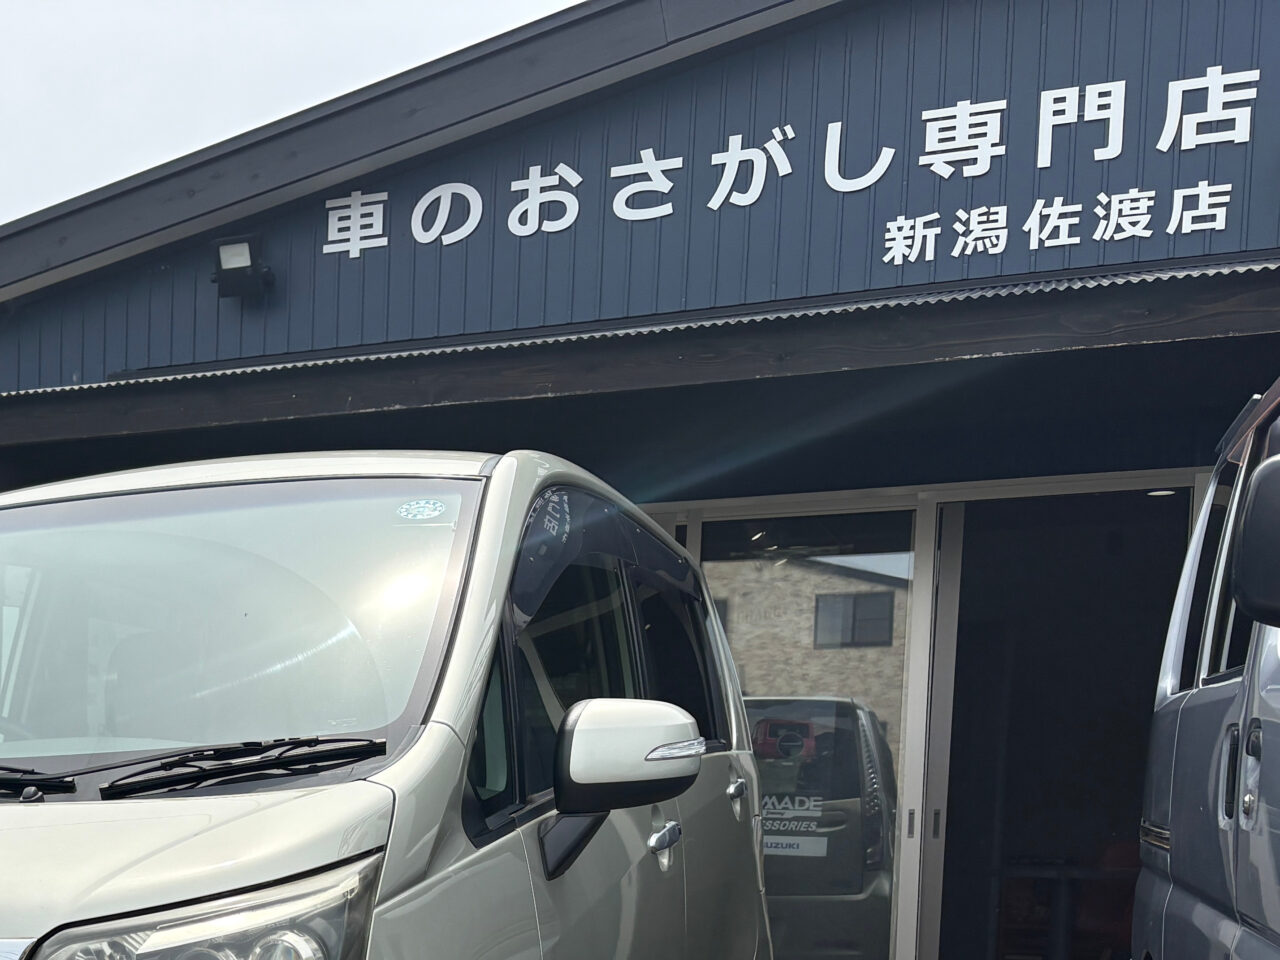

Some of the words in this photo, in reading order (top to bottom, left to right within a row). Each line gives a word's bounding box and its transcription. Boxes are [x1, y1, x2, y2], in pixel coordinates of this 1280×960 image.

[321, 65, 1261, 260] 車のおさがし専門店
[882, 180, 1233, 267] 新潟佐渡店
[763, 820, 818, 832] SSORIES
